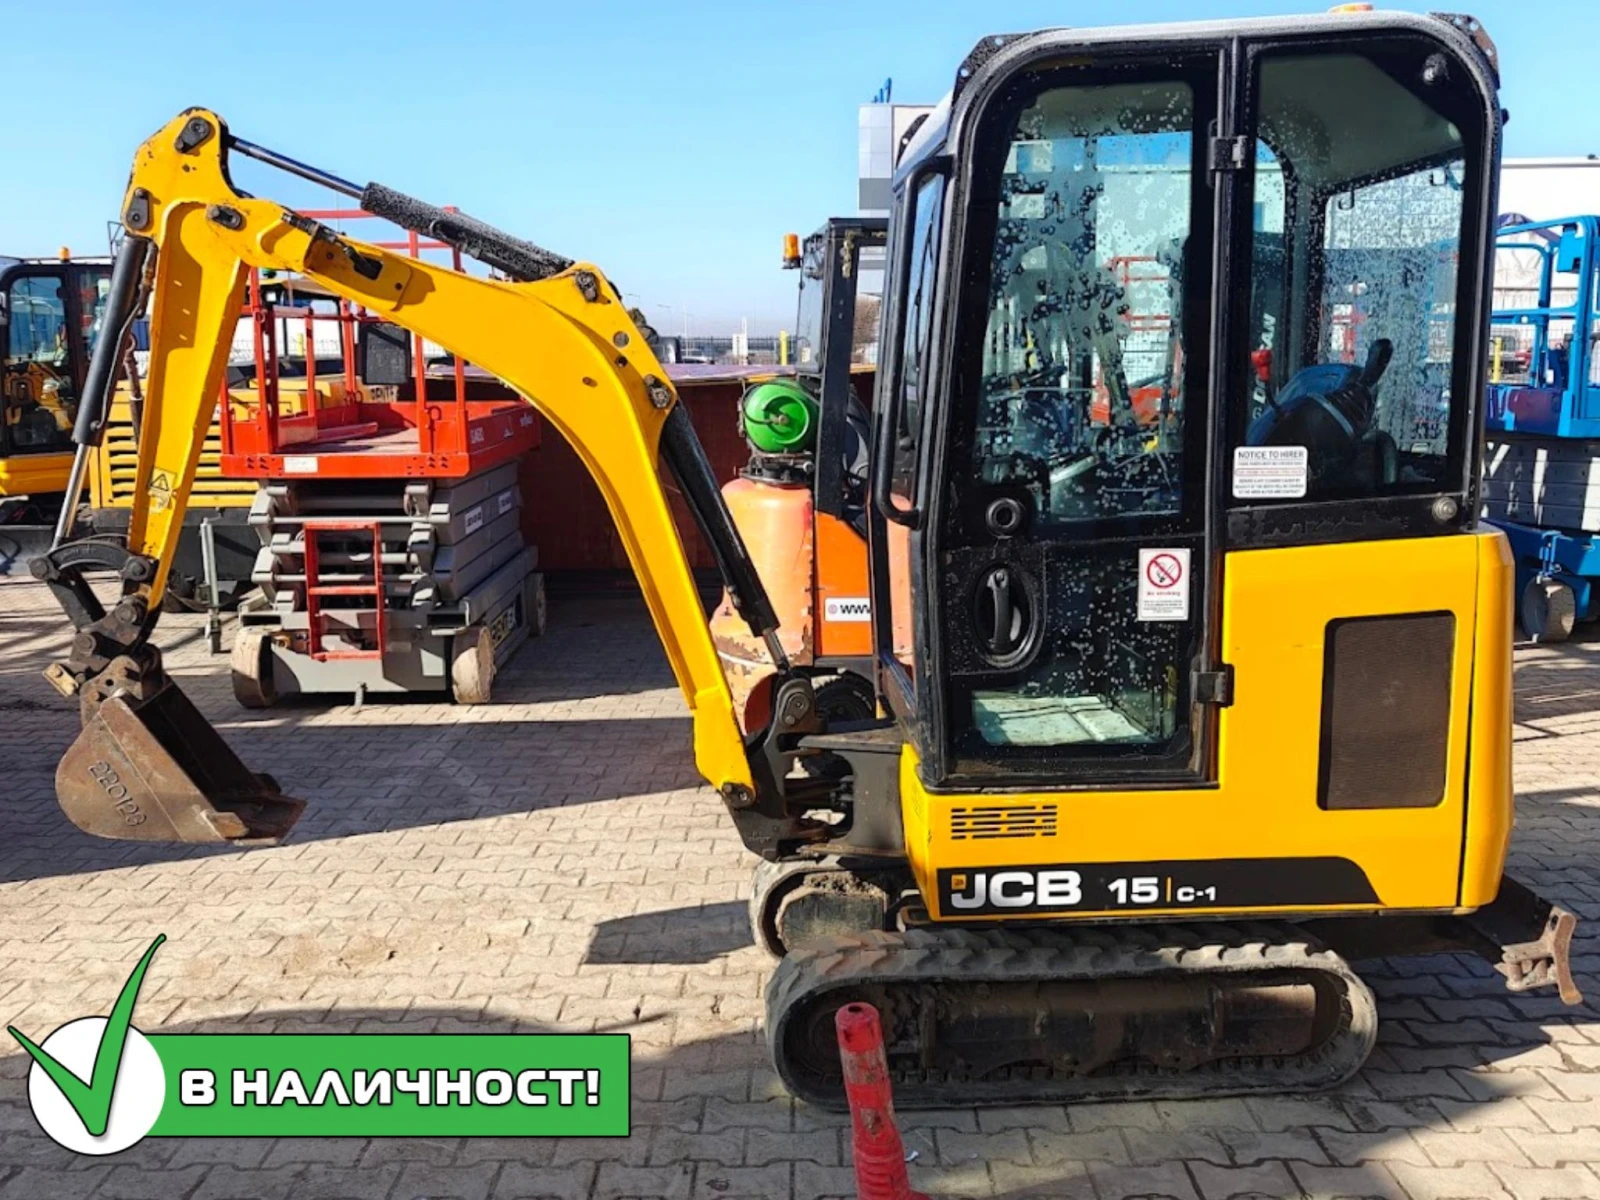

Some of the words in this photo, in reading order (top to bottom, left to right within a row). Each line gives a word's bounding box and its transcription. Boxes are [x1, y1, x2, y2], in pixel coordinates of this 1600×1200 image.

[1238, 450, 1266, 459] NOTICE
[1268, 450, 1280, 458] TO
[1281, 450, 1304, 458] HIRER
[951, 870, 1081, 909] JCB
[1108, 877, 1159, 905] 15
